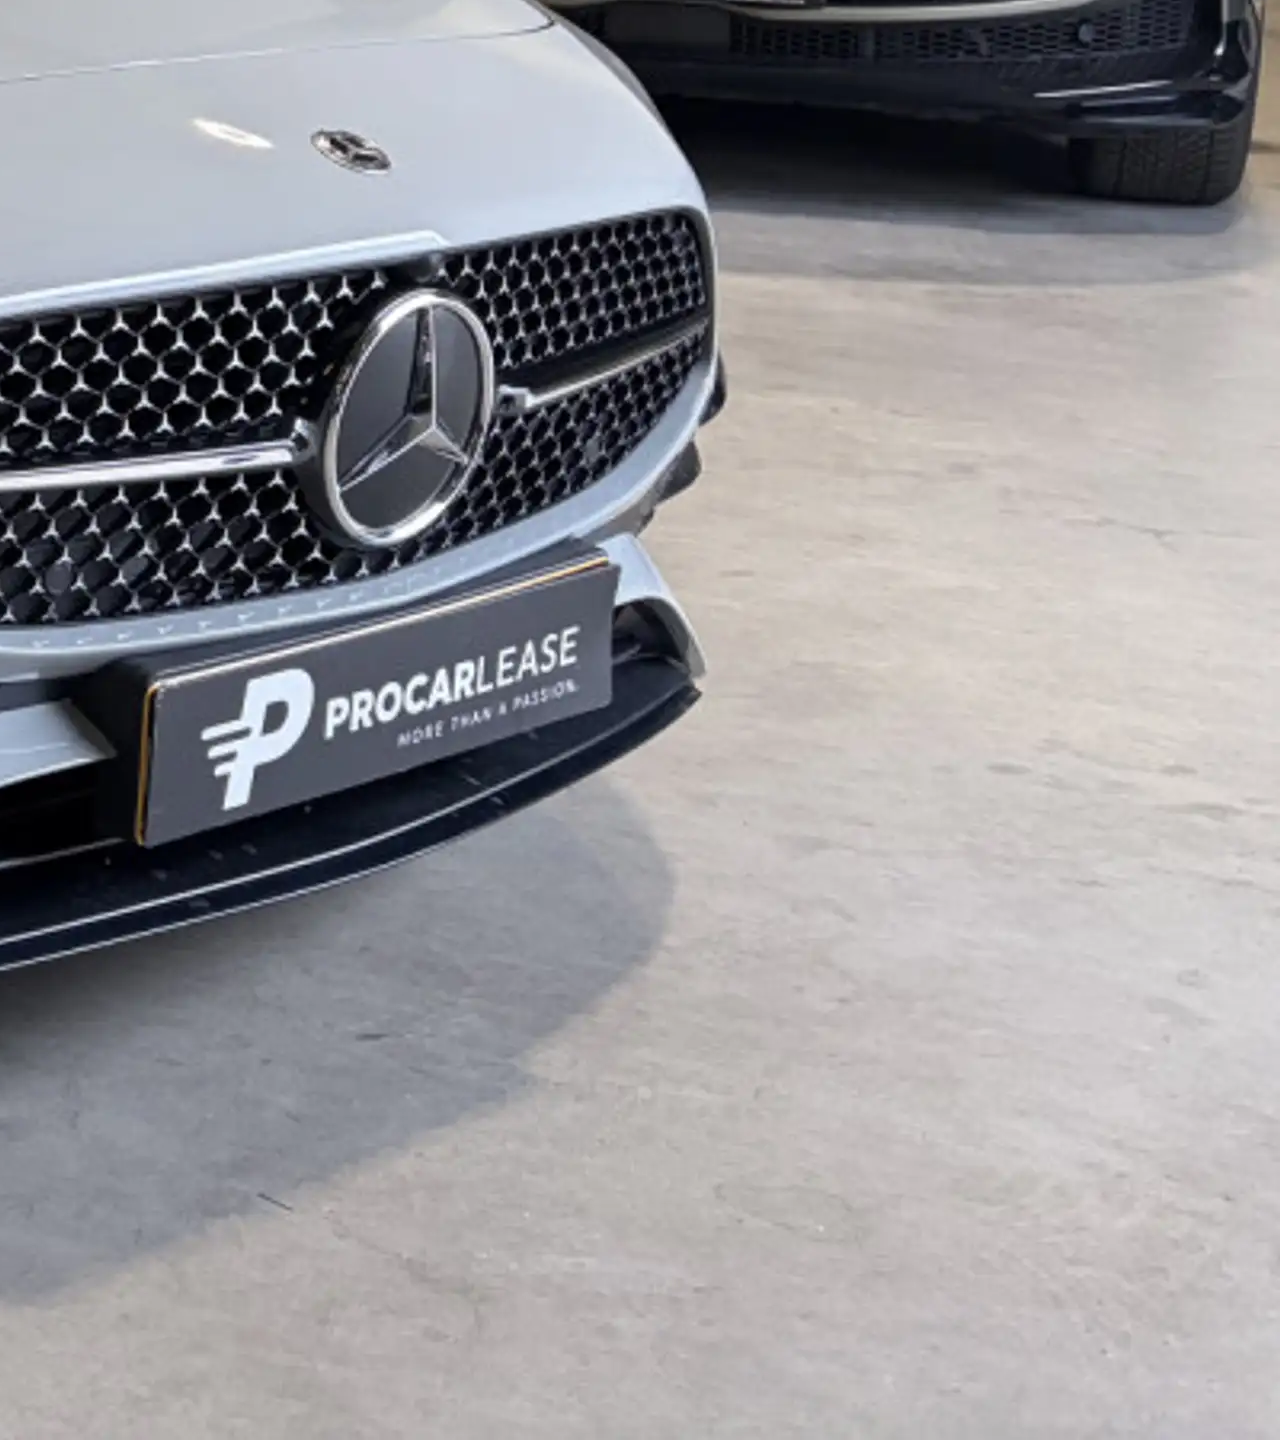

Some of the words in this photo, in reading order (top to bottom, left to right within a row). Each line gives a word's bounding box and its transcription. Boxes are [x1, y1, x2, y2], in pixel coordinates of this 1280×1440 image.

[323, 625, 581, 740] PROCARLEASE
[396, 720, 444, 748] MORE
[450, 707, 493, 731] THAN
